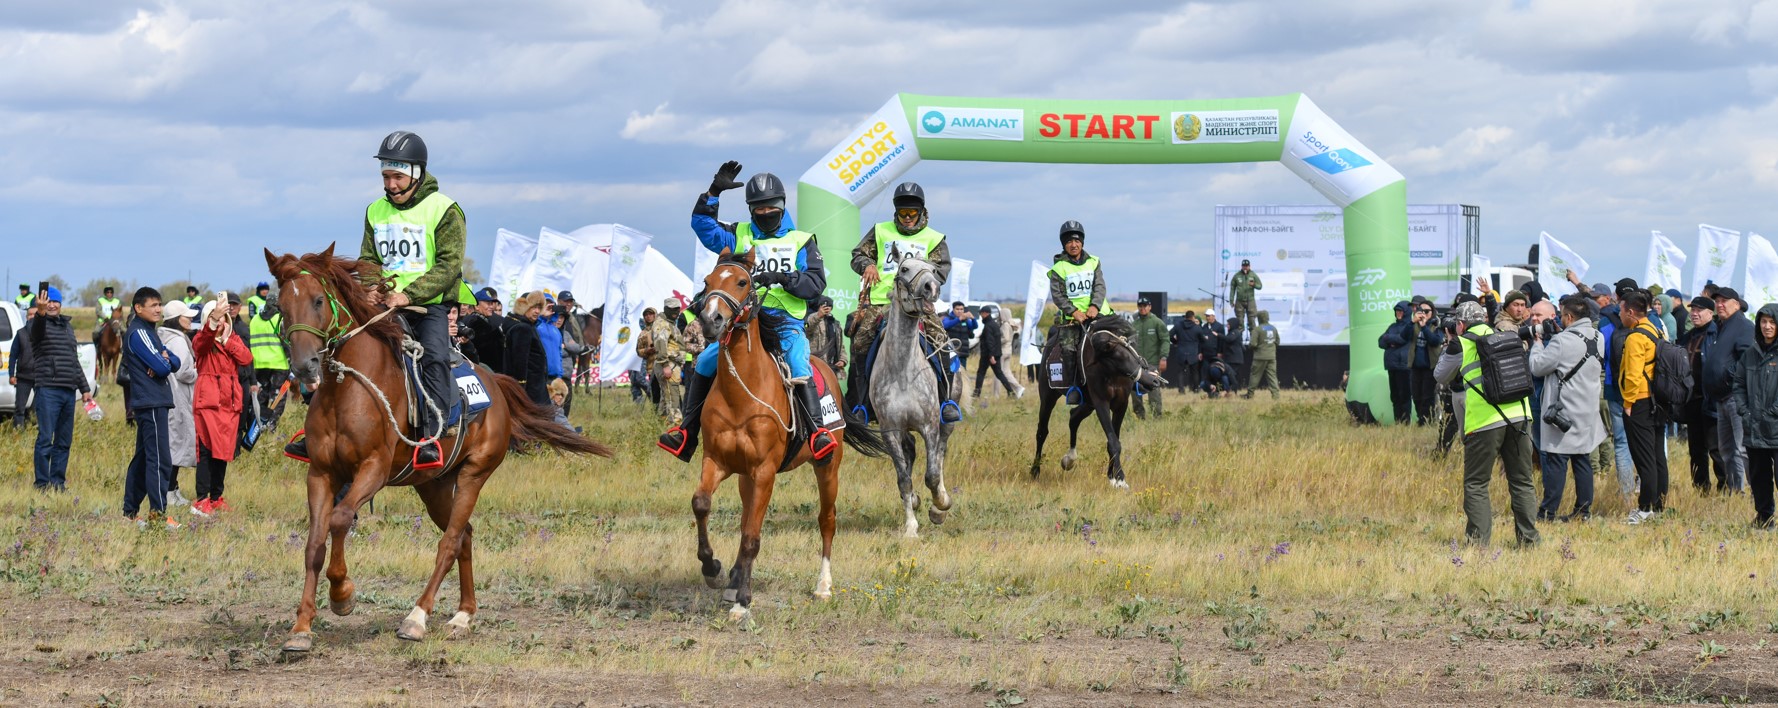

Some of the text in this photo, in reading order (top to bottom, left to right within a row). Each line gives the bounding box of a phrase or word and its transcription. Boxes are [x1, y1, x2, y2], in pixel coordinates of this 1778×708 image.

[951, 117, 1018, 129] AMANAT
[1039, 113, 1160, 140] START
[1205, 127, 1277, 136] МИНИСТРЛІГІ
[828, 121, 888, 171] ULTTYQ
[1303, 131, 1330, 152] Sport
[838, 131, 899, 185] SPORT
[1328, 151, 1353, 170] Qory
[379, 239, 420, 258] 0401
[827, 288, 857, 300] DALA
